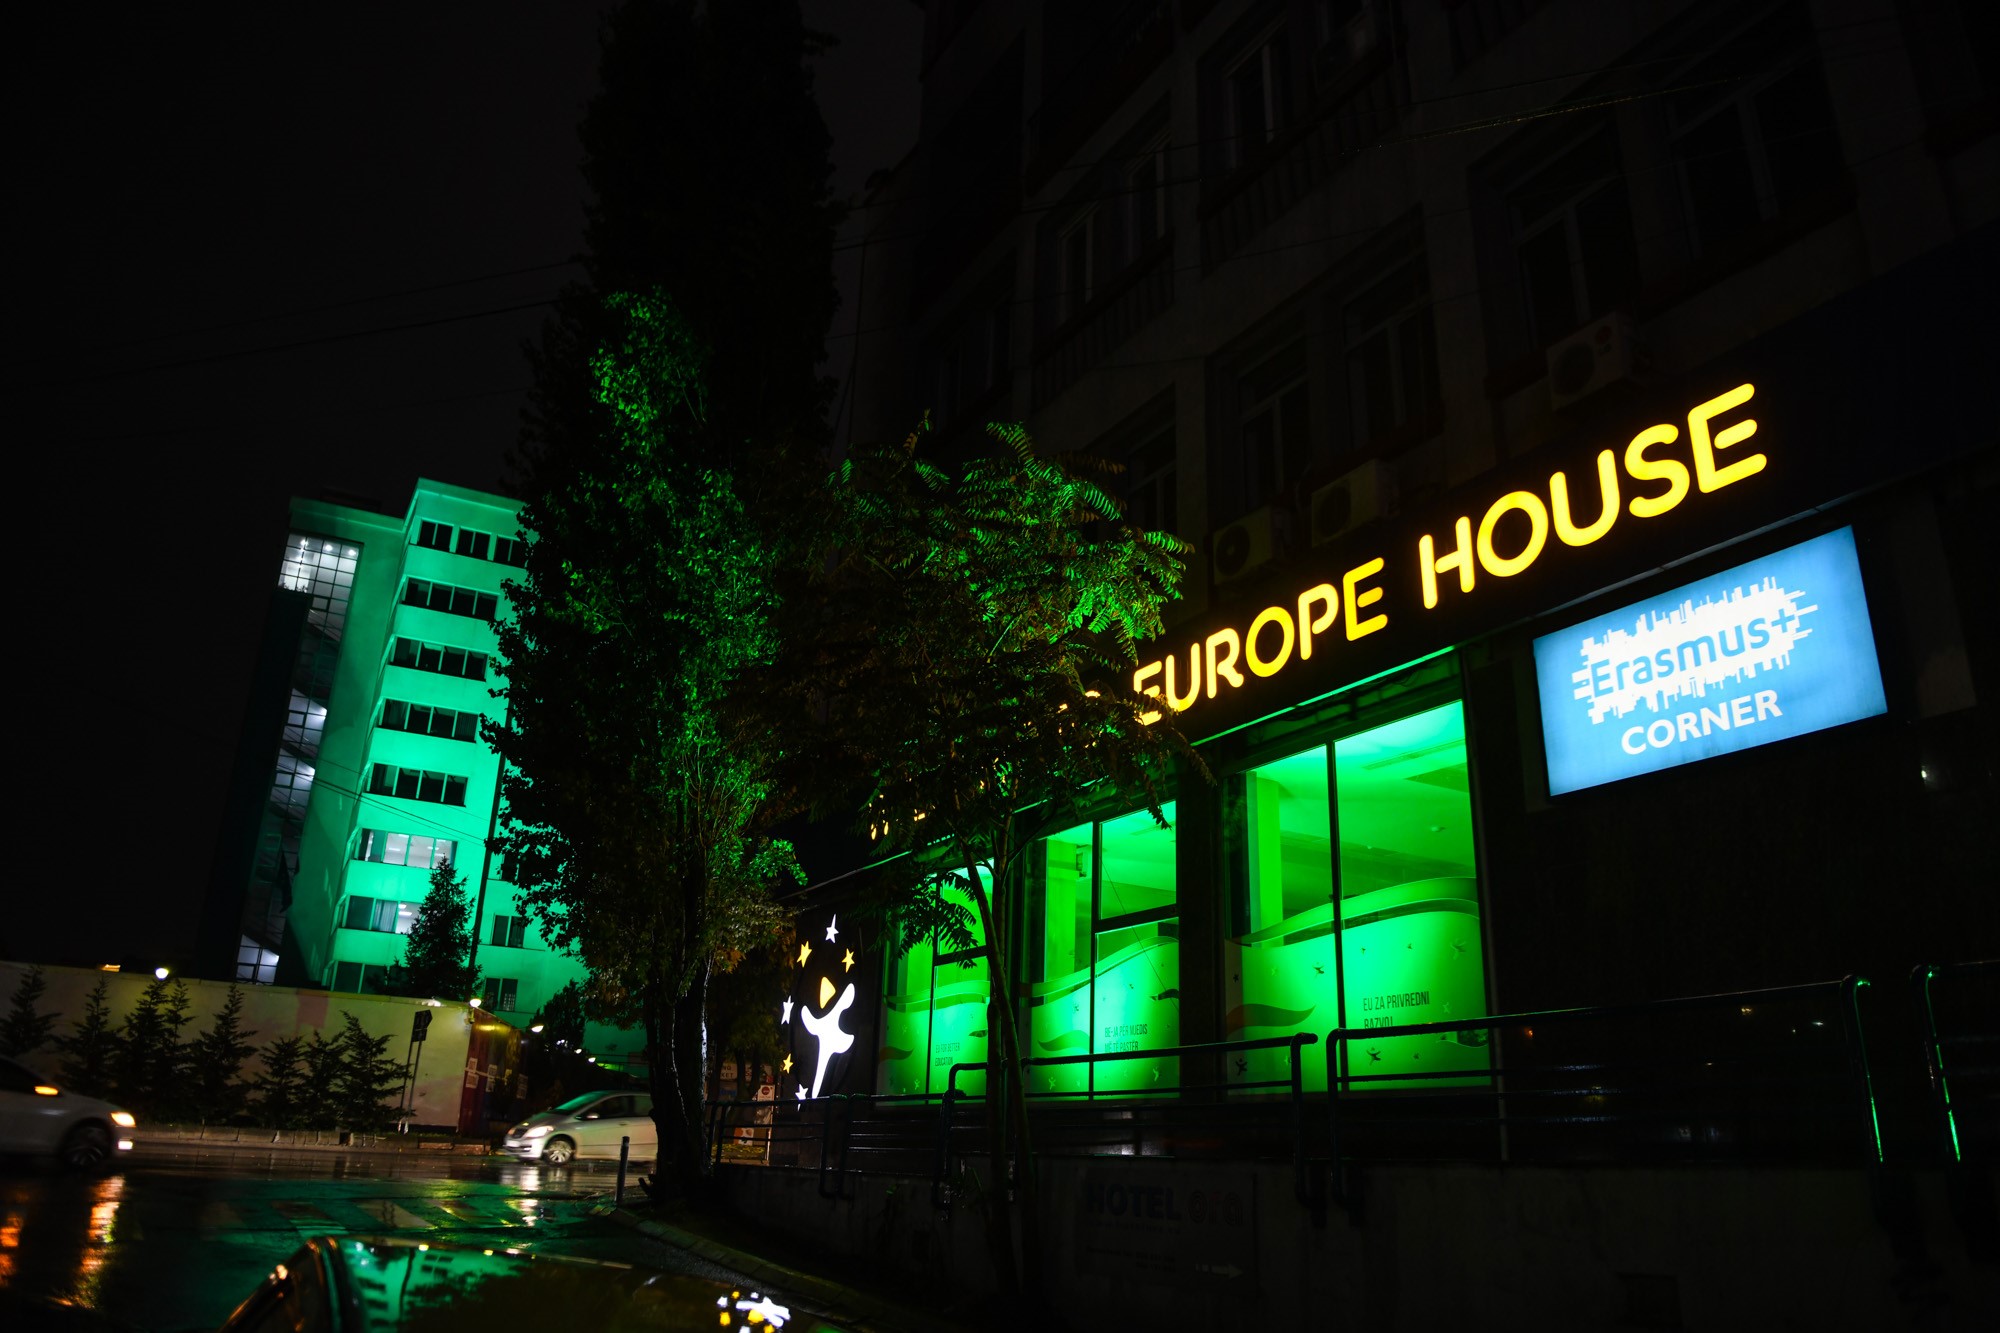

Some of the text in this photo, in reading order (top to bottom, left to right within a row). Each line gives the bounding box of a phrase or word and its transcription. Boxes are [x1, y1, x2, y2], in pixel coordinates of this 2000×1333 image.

[1133, 383, 1768, 725] EUROPE HOUSE
[1590, 609, 1797, 698] Erasmus+
[1621, 690, 1783, 755] CORNER
[1363, 991, 1430, 1011] EU ZA PRIVREDNI
[1087, 1183, 1183, 1221] HOTEL
